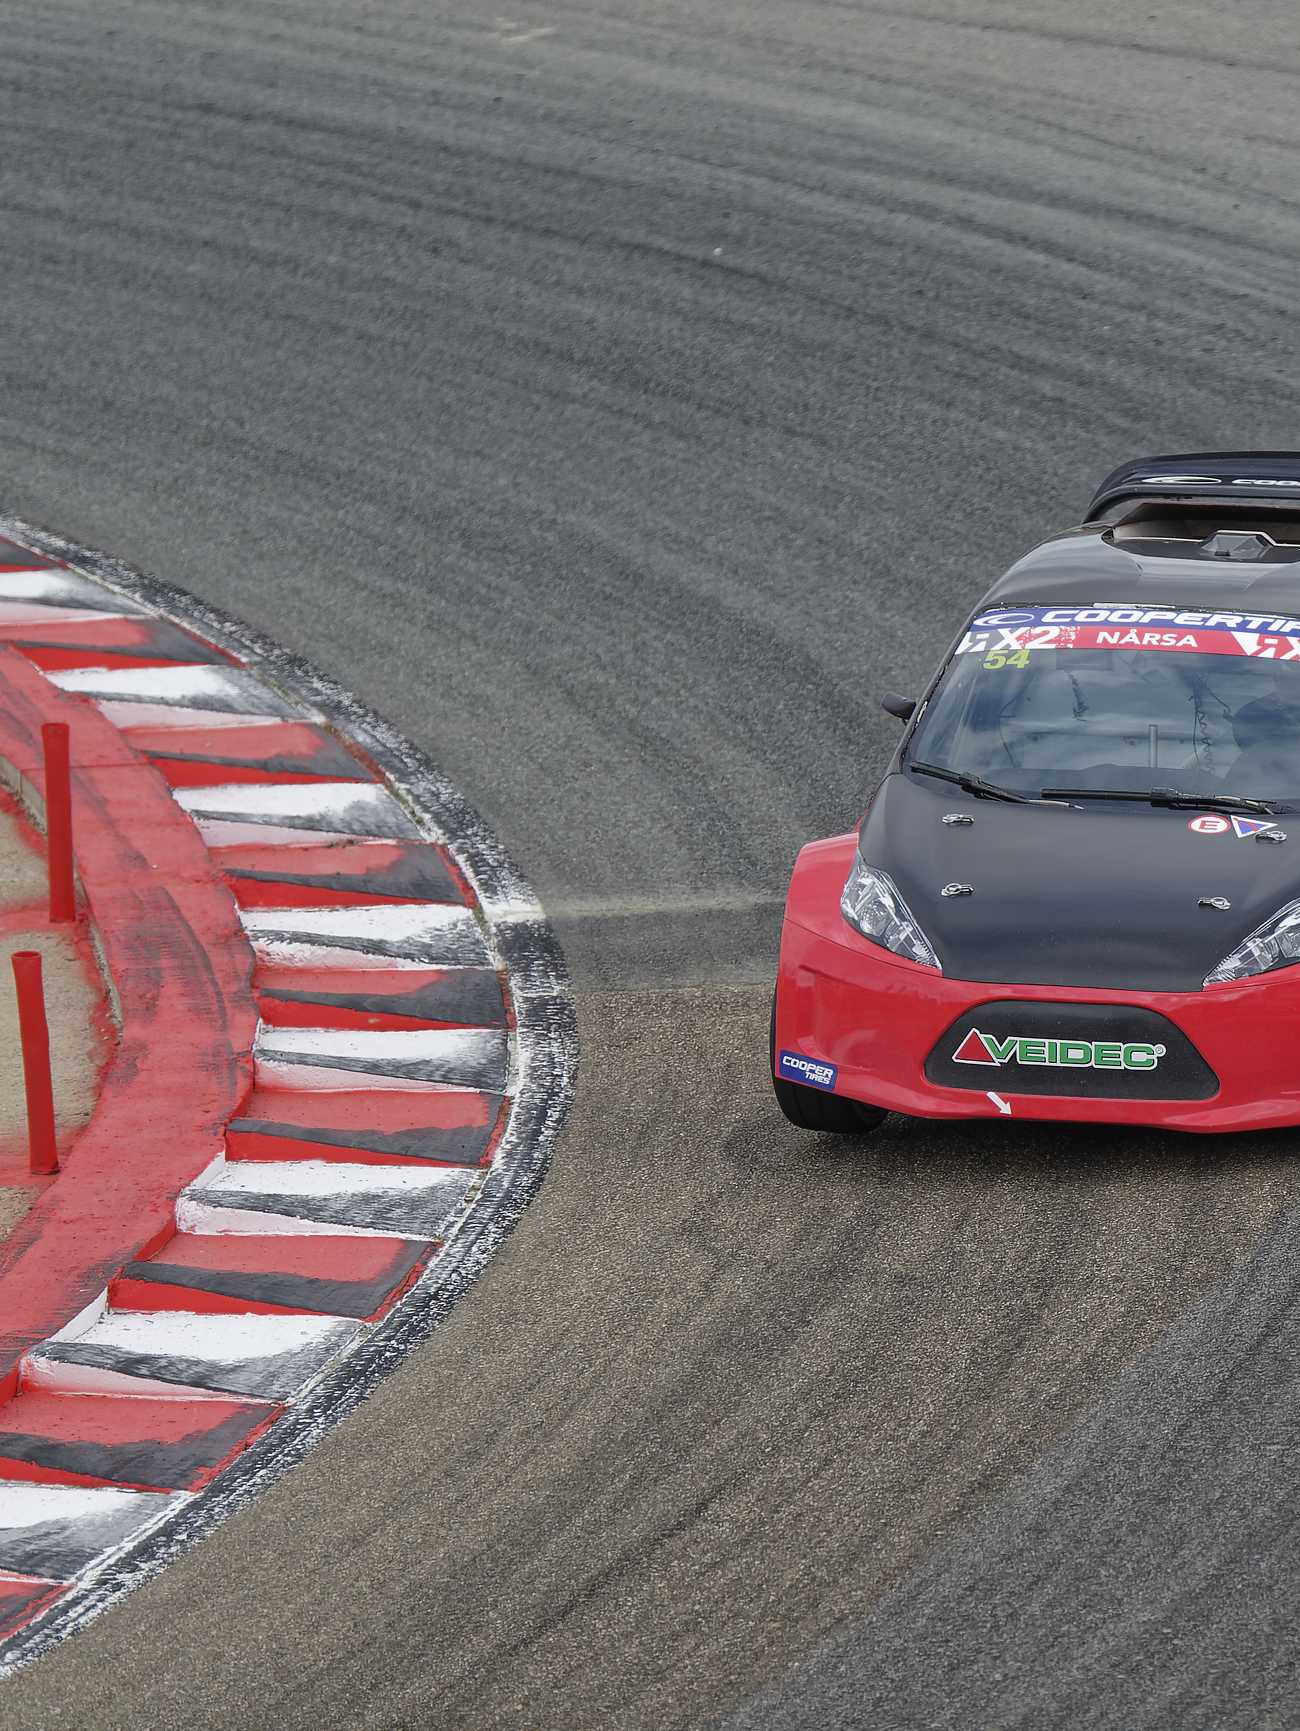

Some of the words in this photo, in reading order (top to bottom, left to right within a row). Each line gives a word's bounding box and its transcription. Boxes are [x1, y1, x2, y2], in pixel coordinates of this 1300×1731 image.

[1095, 628, 1199, 648] NÅRSA
[982, 649, 1031, 670] 54
[983, 1034, 1158, 1070] VEIDEC
[782, 1055, 834, 1079] COOPER
[804, 1071, 831, 1085] TIRES
